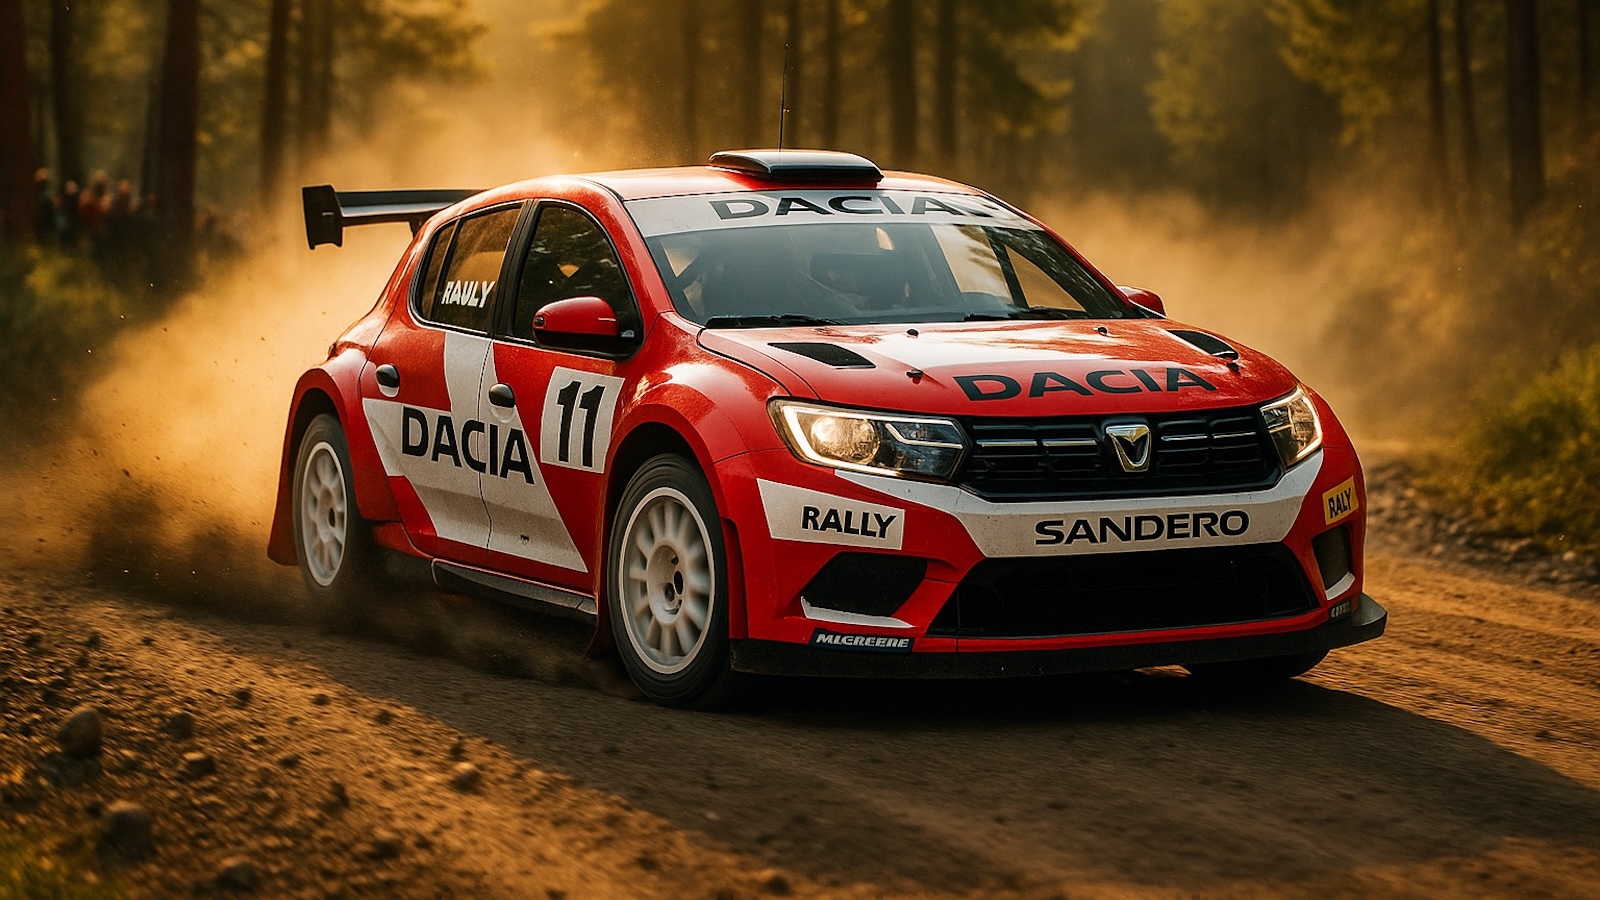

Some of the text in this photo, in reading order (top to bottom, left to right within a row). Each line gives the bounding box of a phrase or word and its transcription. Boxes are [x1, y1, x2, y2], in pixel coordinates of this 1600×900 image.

[709, 196, 967, 220] DACIA
[953, 367, 1217, 402] DACIA
[557, 381, 605, 467] 11
[402, 406, 535, 484] DACIA
[1328, 487, 1352, 519] RALY
[801, 506, 897, 538] RALLY
[1035, 510, 1250, 546] SANDERO
